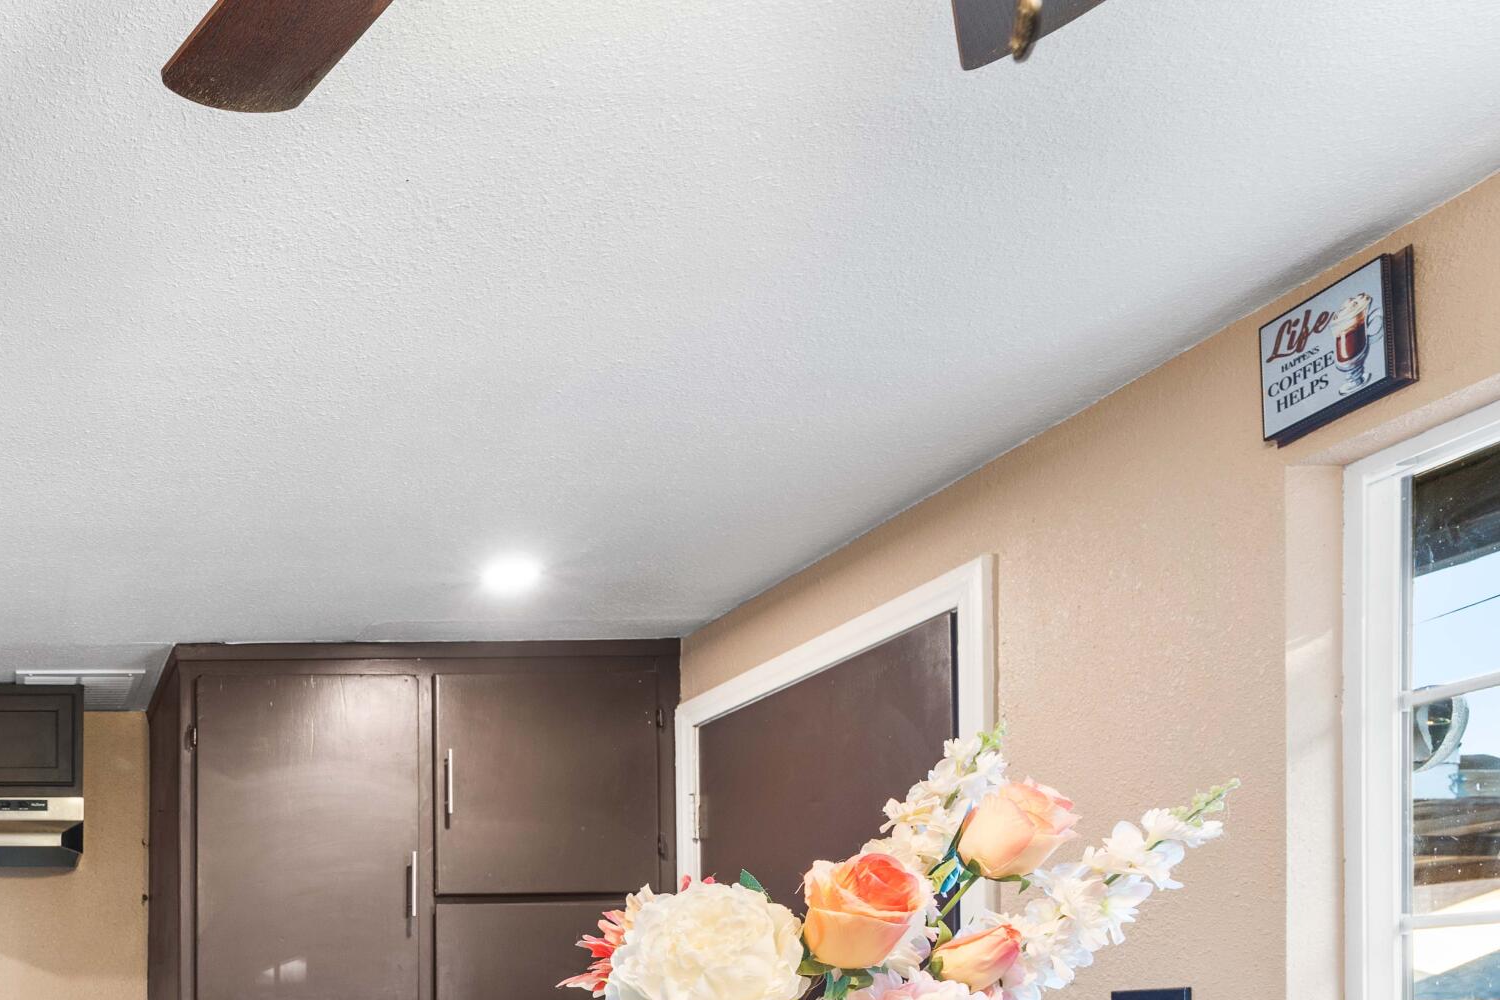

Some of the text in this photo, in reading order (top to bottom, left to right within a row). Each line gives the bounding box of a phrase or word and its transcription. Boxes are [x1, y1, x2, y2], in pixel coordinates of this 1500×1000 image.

[1266, 309, 1335, 363] Life
[1267, 350, 1335, 398] COFFEE
[1280, 345, 1320, 372] HAPPENS
[1276, 374, 1329, 413] HELPS
